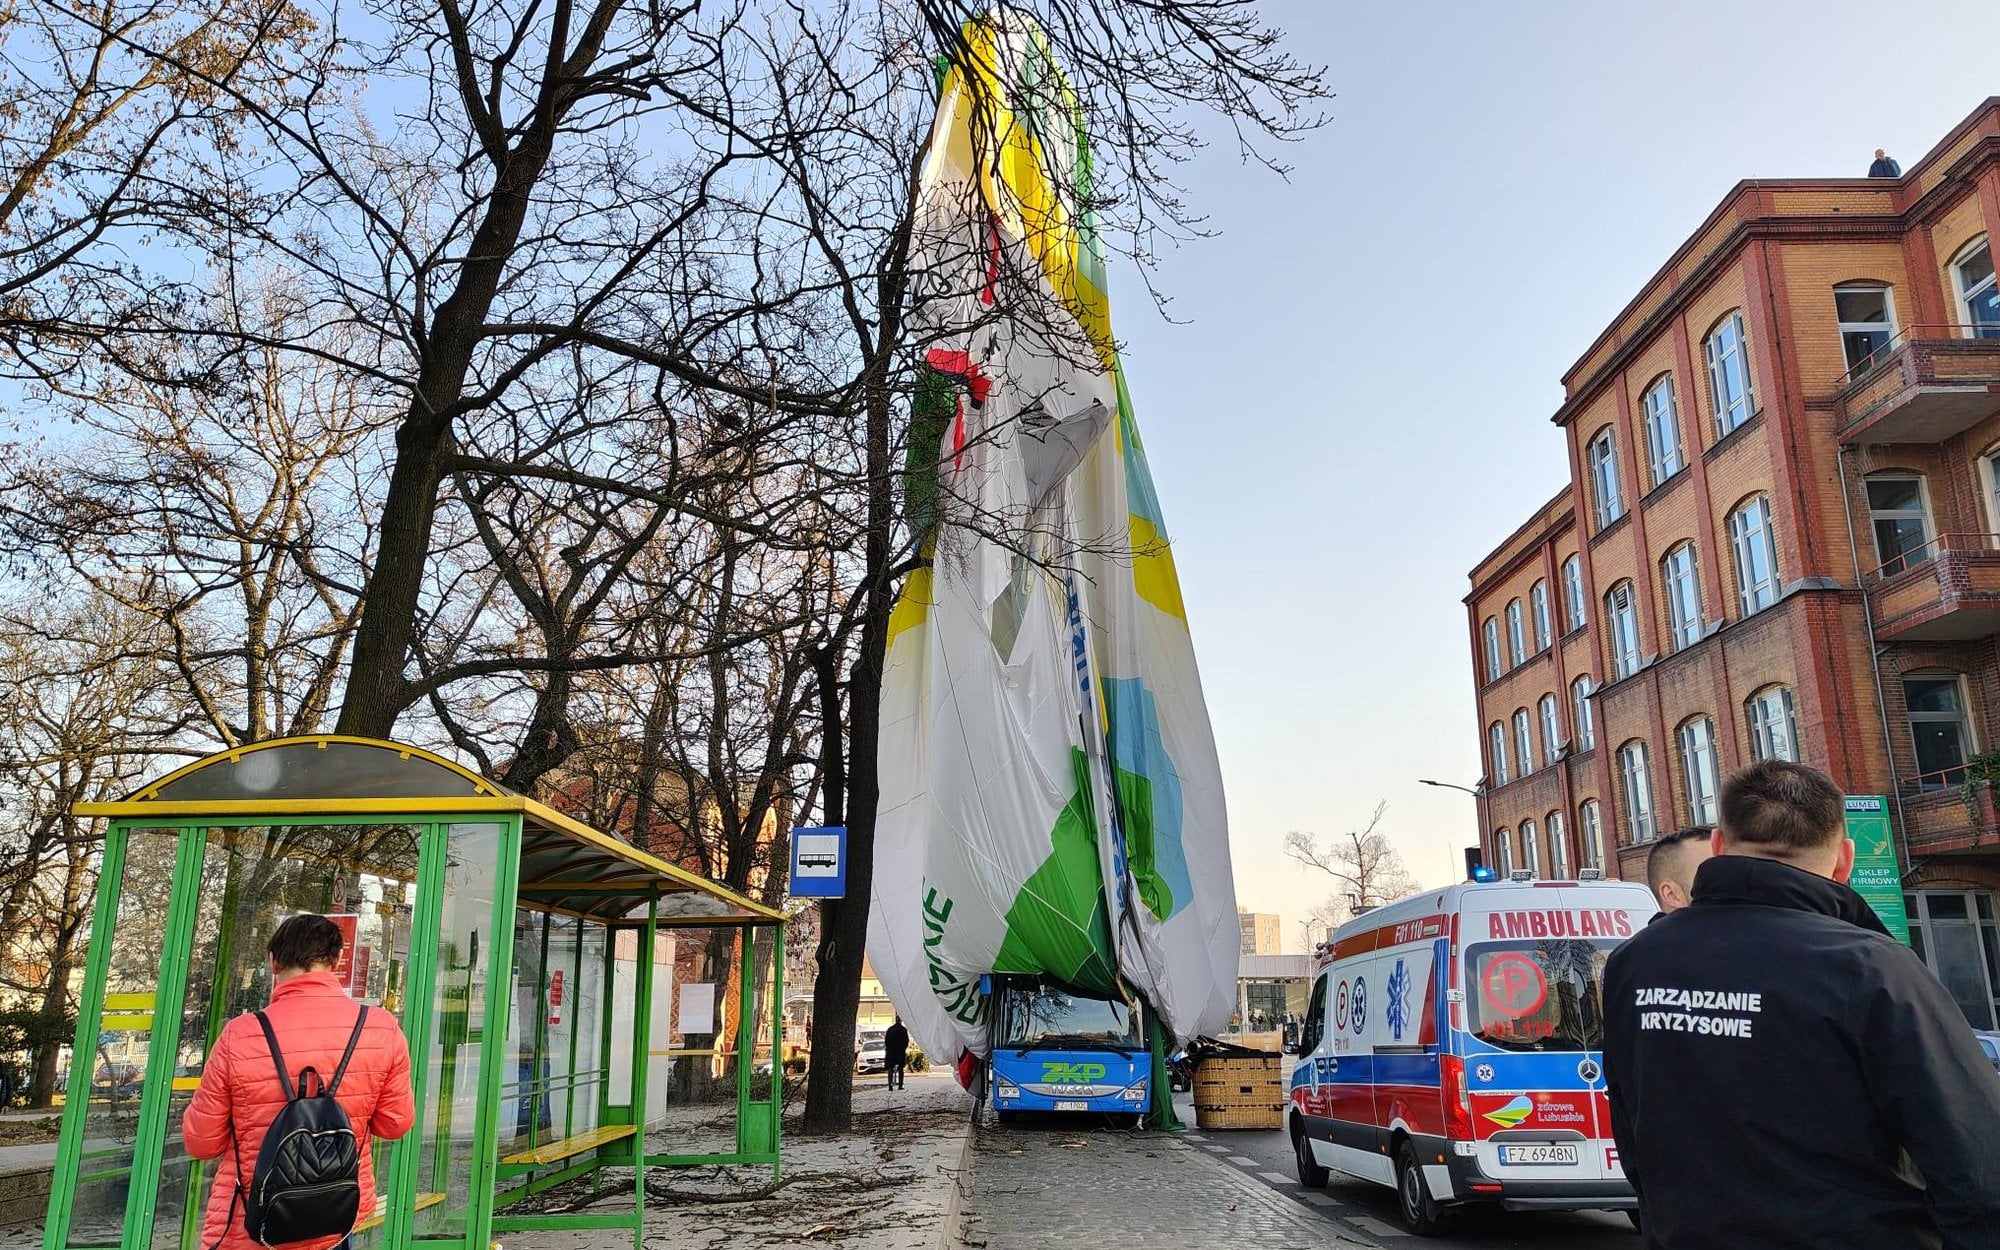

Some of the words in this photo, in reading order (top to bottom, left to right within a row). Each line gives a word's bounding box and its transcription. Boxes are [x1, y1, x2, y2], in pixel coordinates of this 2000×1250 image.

[1852, 877, 1899, 885] FIRMOWY
[1410, 920, 1423, 940] 110
[1488, 910, 1632, 939] AMBULANS
[1635, 987, 1762, 1012] ZARZĄDZANIE
[1640, 1011, 1753, 1038] KRYZYSOWE
[1041, 1062, 1106, 1083] ZKP
[1052, 1085, 1093, 1095] IVECO
[1537, 1102, 1574, 1111] zdrowe
[1537, 1112, 1585, 1122] Lubuskie
[1508, 1147, 1528, 1162] FZ
[1531, 1147, 1574, 1162] 6948N
